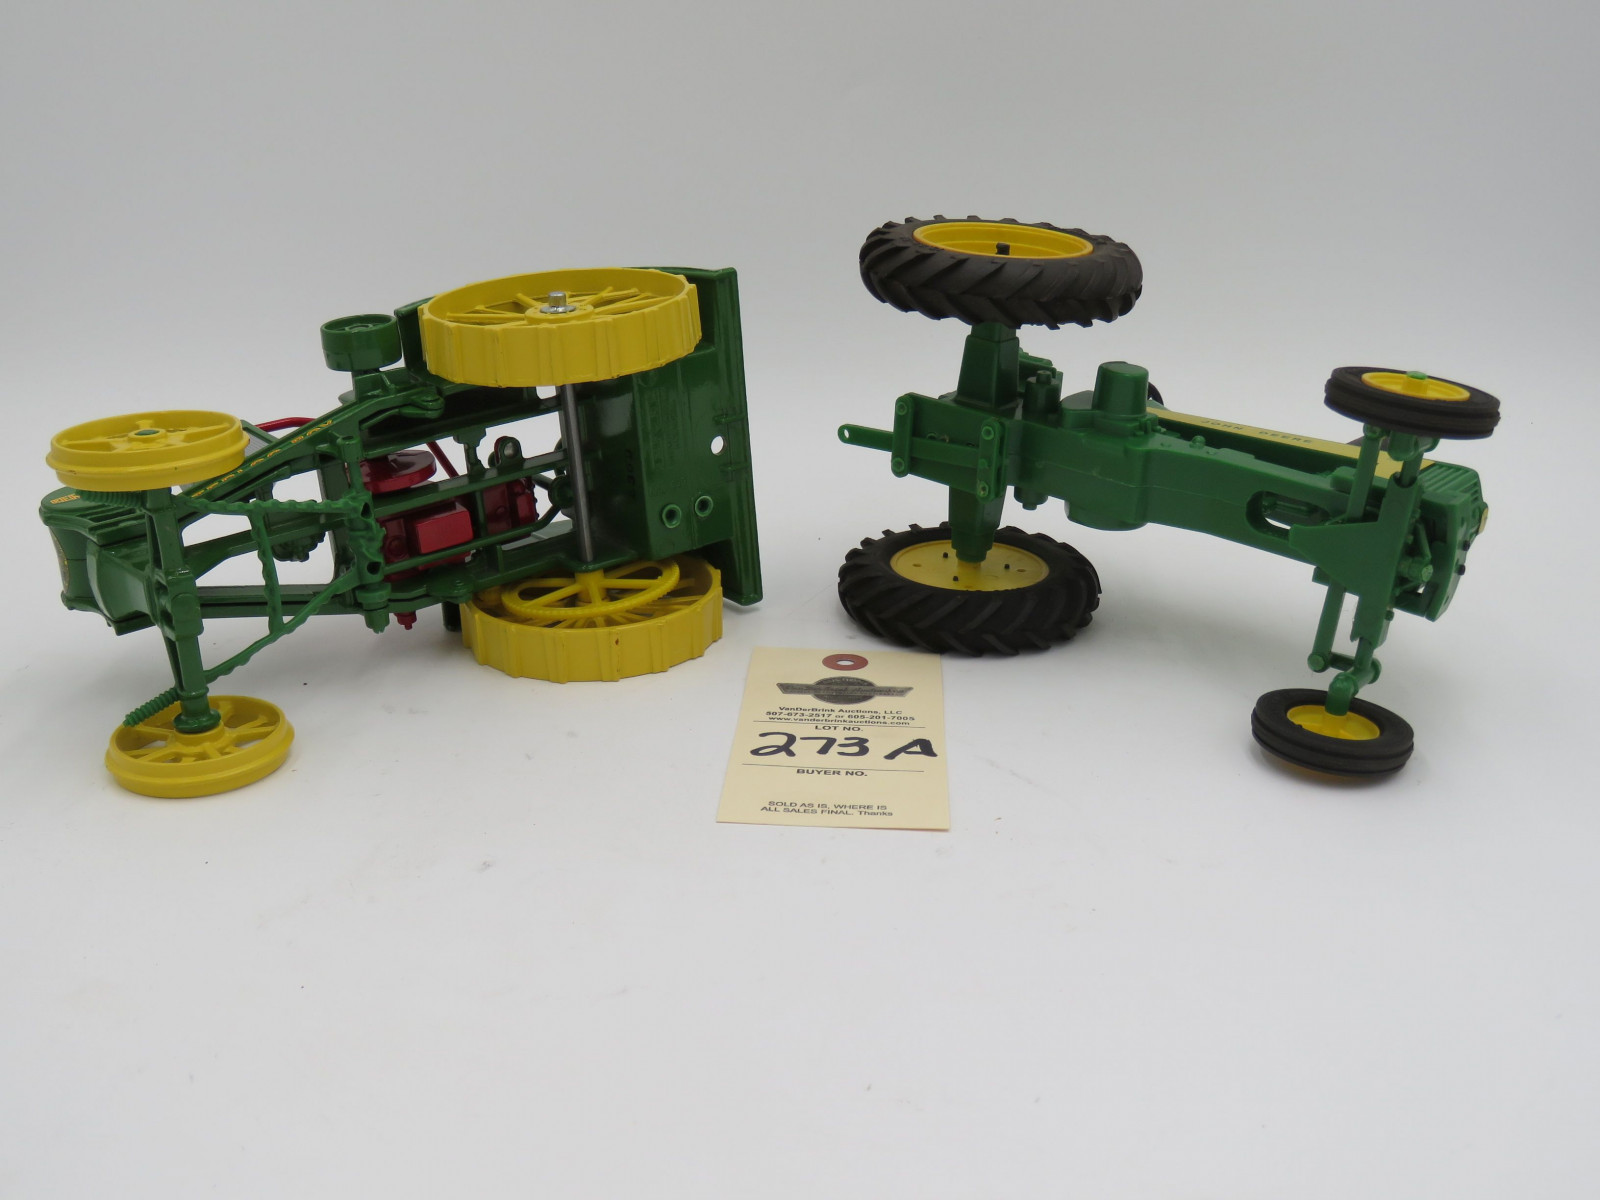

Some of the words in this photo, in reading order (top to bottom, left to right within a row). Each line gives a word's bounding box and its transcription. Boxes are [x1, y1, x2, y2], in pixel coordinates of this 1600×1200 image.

[769, 717, 910, 725] www.vanderbrinkauctions.com
[750, 732, 869, 757] 273
[884, 738, 938, 760] A
